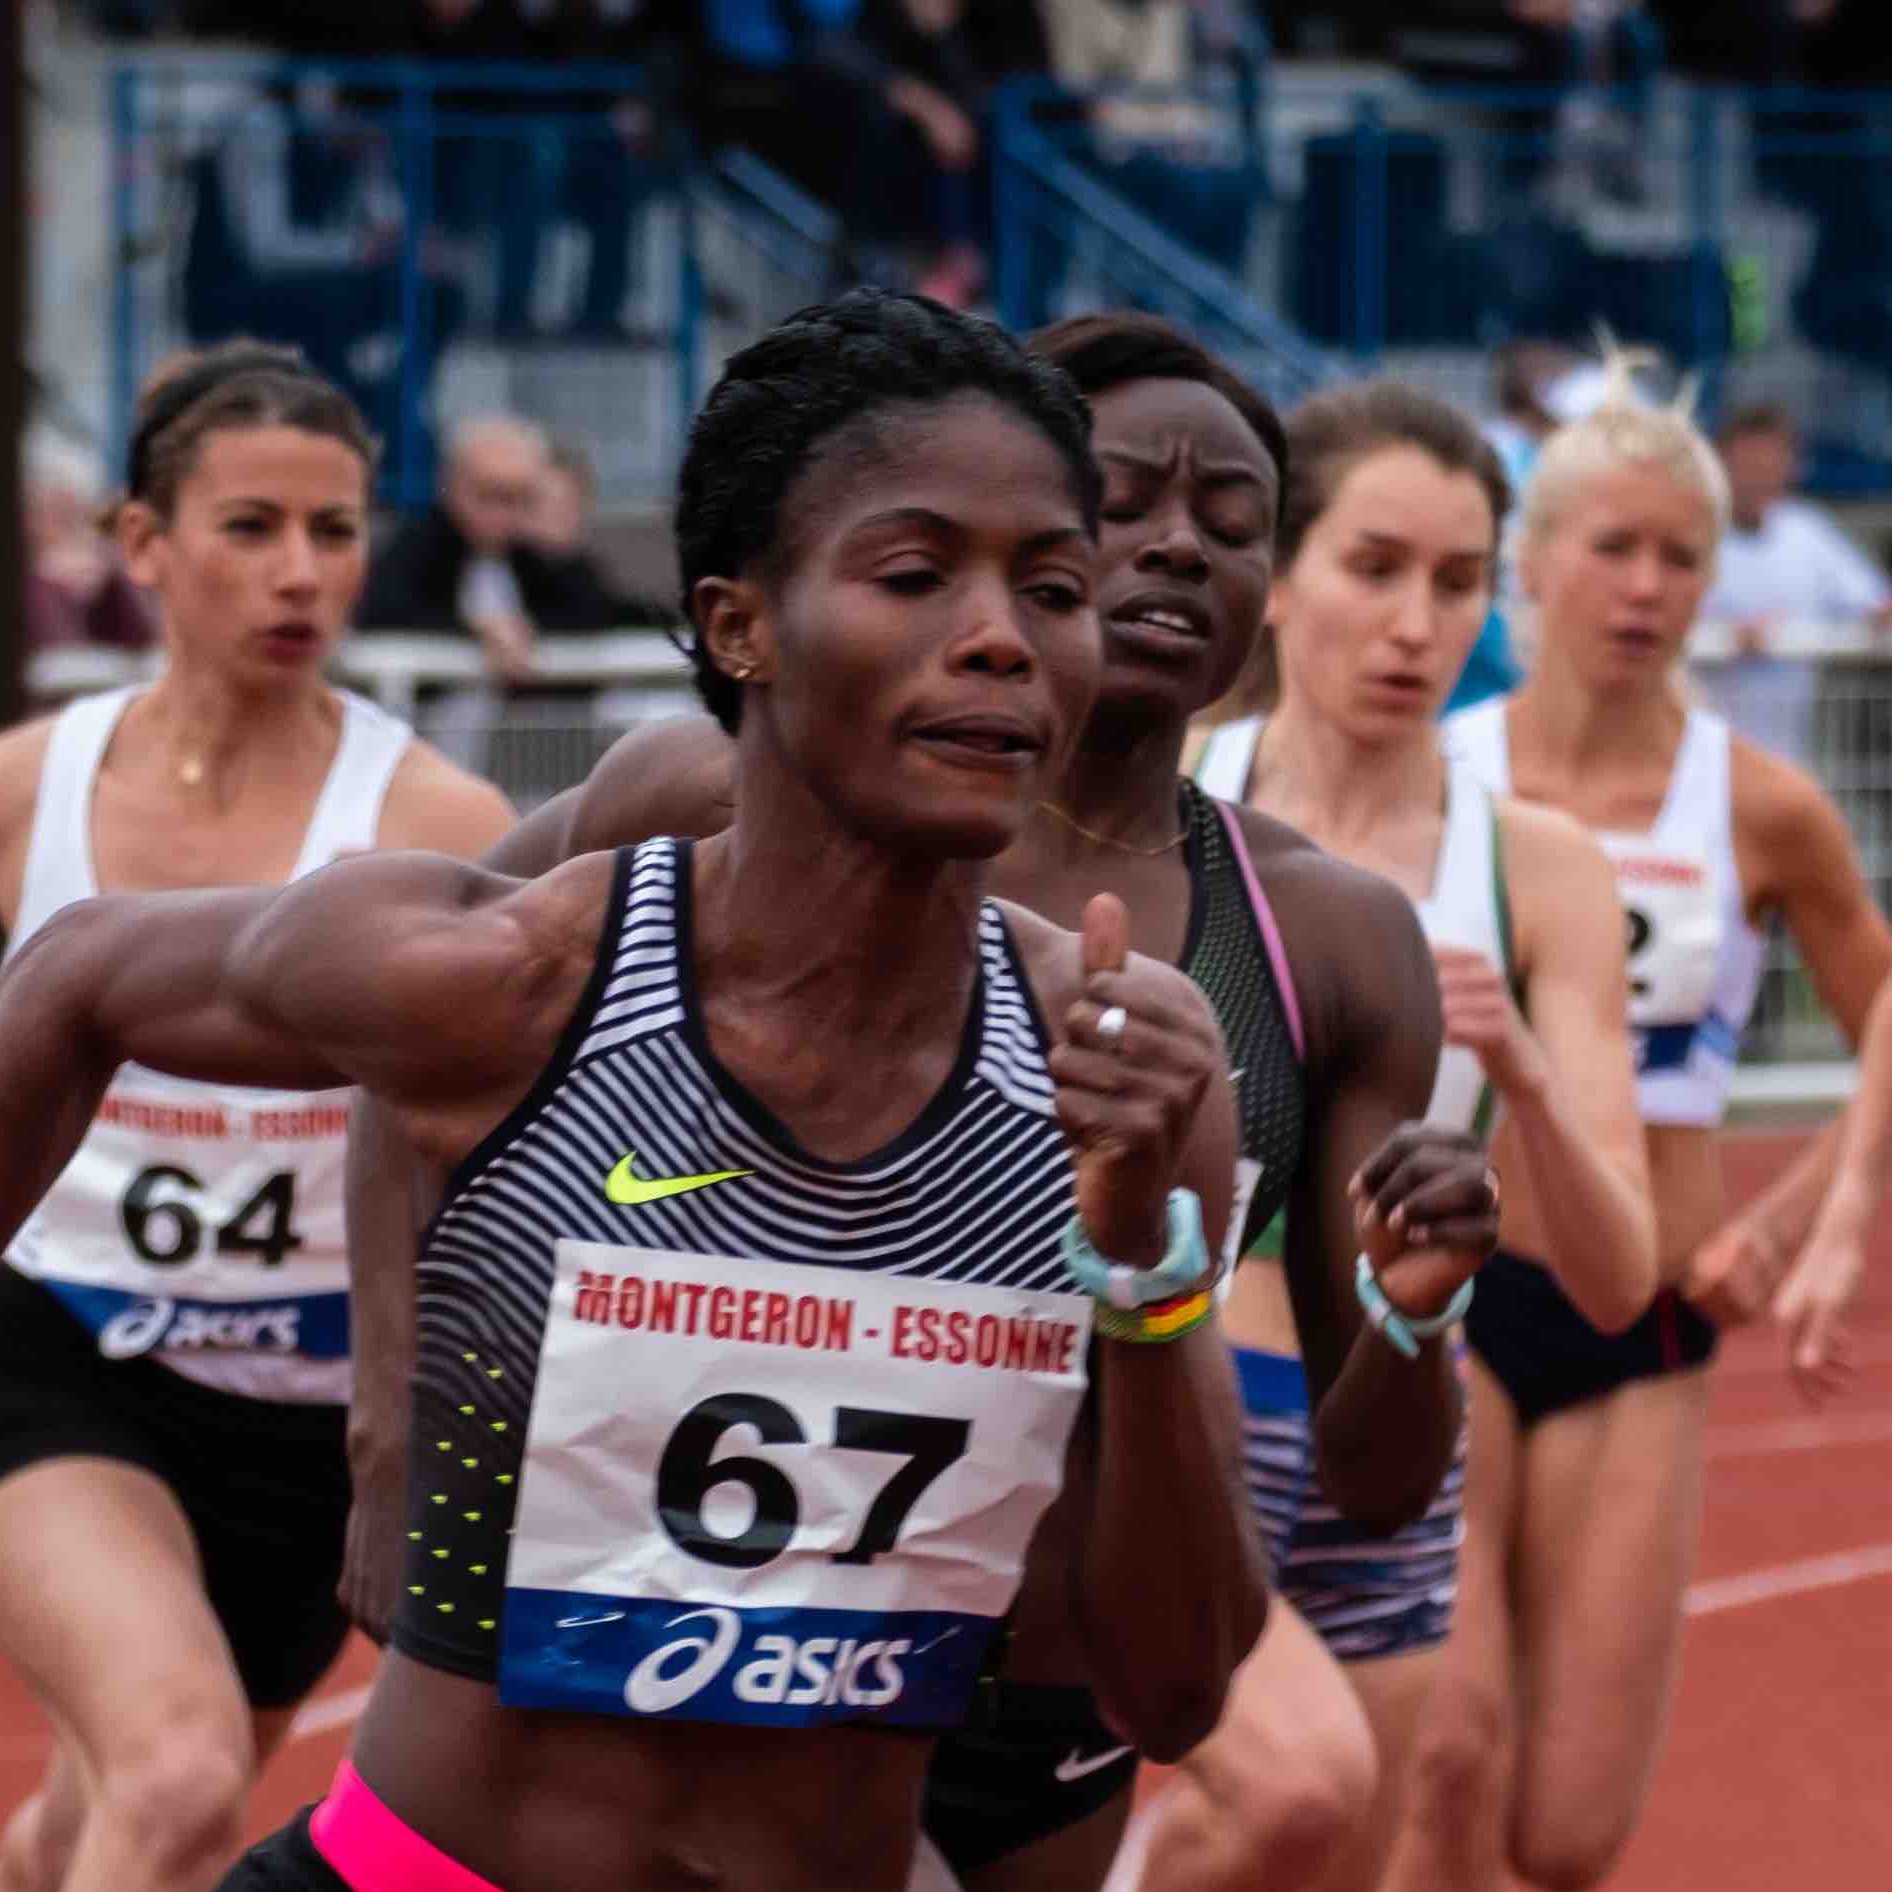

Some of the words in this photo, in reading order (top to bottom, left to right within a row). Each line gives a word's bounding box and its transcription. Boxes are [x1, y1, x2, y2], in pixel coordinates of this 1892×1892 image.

[122, 1165, 303, 1266] 64
[574, 1270, 852, 1350] MONTGERON
[892, 1306, 1077, 1373] ESSONNE
[656, 1391, 974, 1569] 67
[733, 1635, 912, 1705] asics
